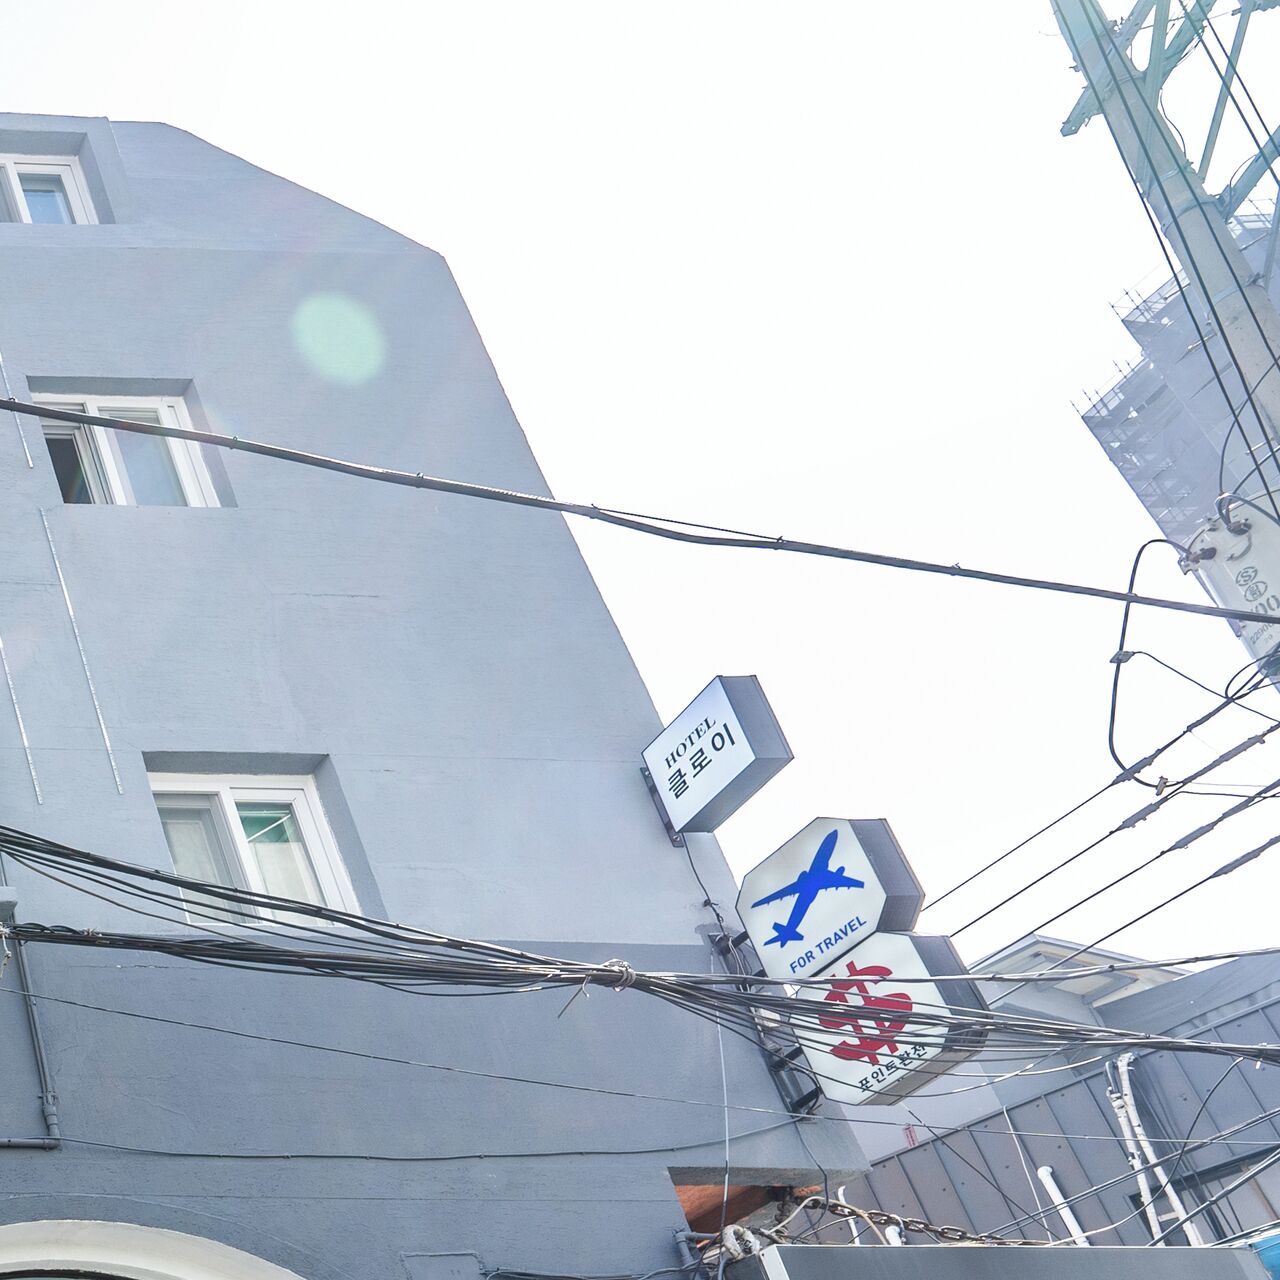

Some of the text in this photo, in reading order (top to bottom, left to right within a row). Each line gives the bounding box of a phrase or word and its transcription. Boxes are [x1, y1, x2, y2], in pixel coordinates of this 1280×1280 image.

[664, 715, 716, 769] HOTEL
[667, 723, 736, 800] 클로이
[789, 915, 867, 975] FOR TRAVEL
[858, 1044, 927, 1093] 포인트환전
